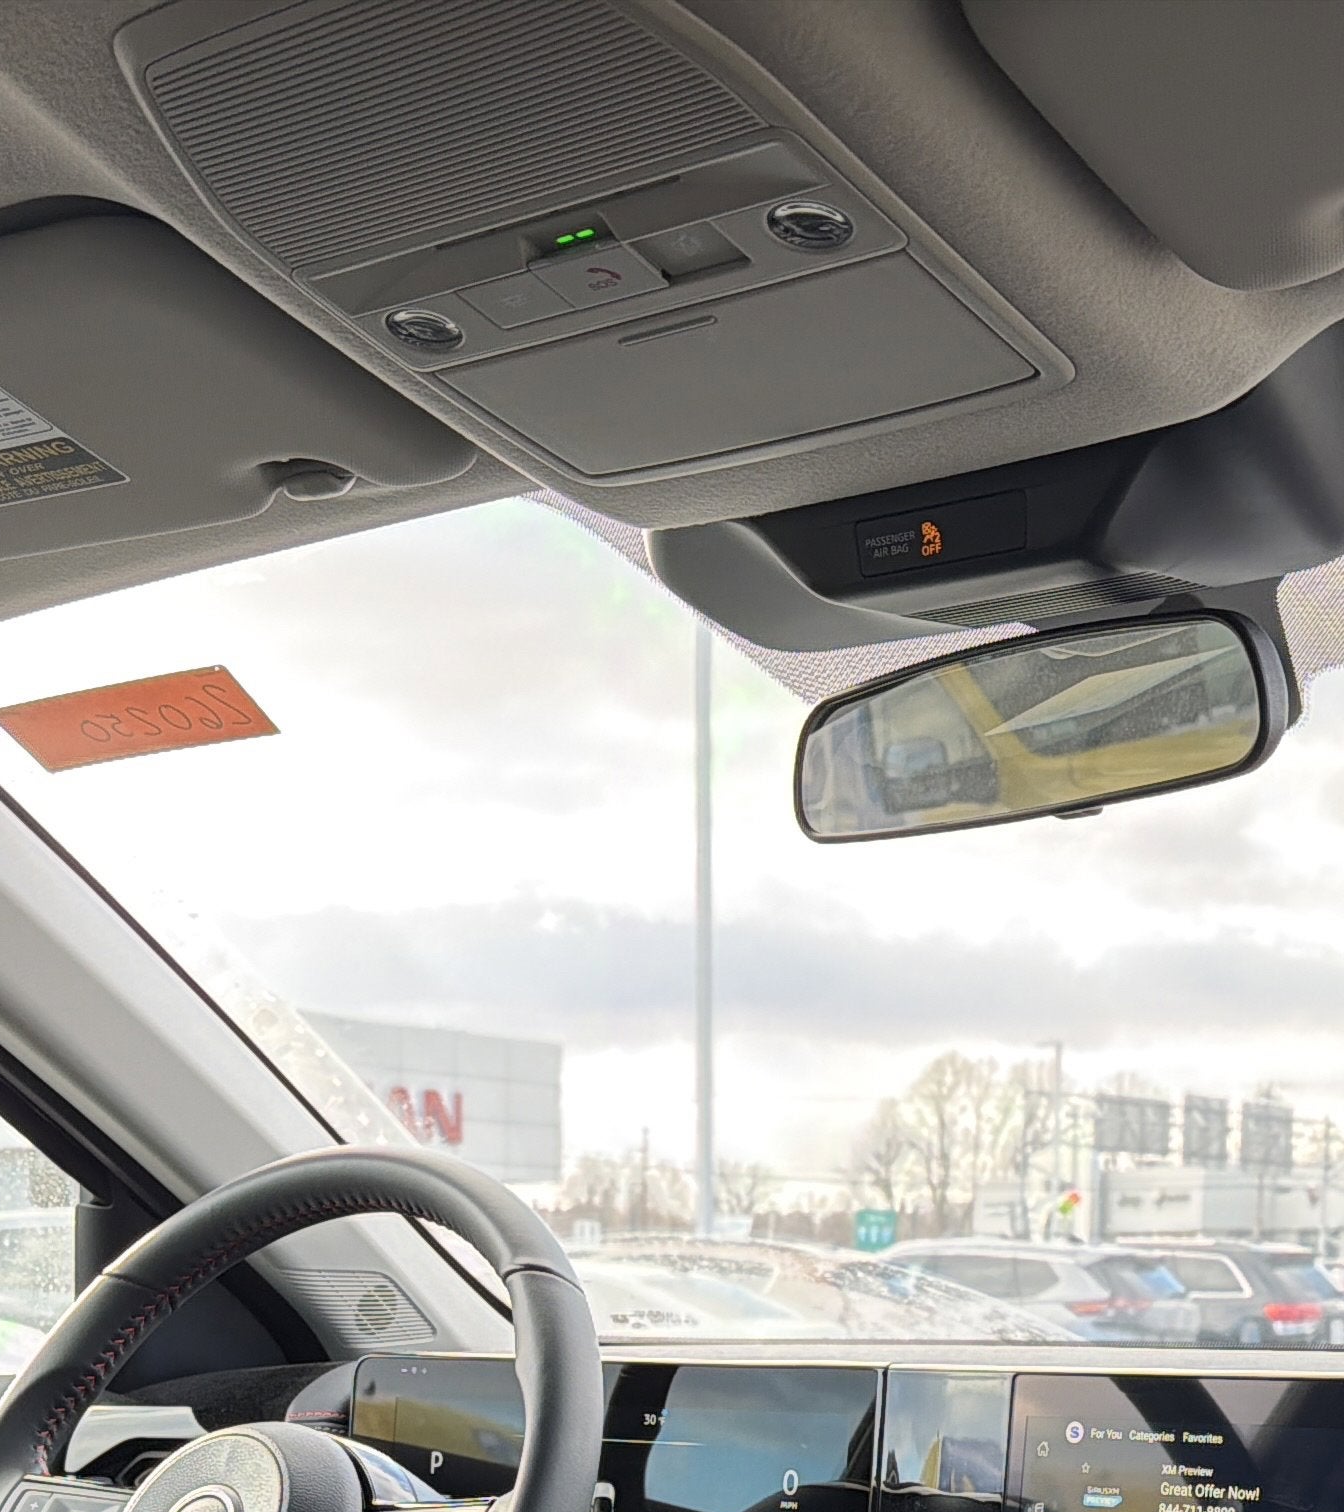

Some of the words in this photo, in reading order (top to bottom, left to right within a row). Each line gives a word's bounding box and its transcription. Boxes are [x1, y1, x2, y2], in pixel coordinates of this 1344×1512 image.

[11, 463, 45, 476] OVER
[865, 530, 916, 547] PASSENGER
[872, 547, 888, 559] AIR
[891, 543, 909, 557] BAG
[921, 543, 942, 557] OFF
[1090, 1428, 1105, 1439] For
[1106, 1428, 1123, 1440] You
[1129, 1429, 1176, 1443] Categories
[1182, 1431, 1223, 1444] Favorites
[430, 1451, 444, 1475] P
[1161, 1464, 1177, 1475] XM
[1178, 1464, 1214, 1478] Preview
[782, 1469, 799, 1496] 0
[1160, 1481, 1193, 1497] Great
[1194, 1483, 1226, 1499] Offer
[1228, 1486, 1260, 1501] Now!
[779, 1501, 798, 1510] MPH
